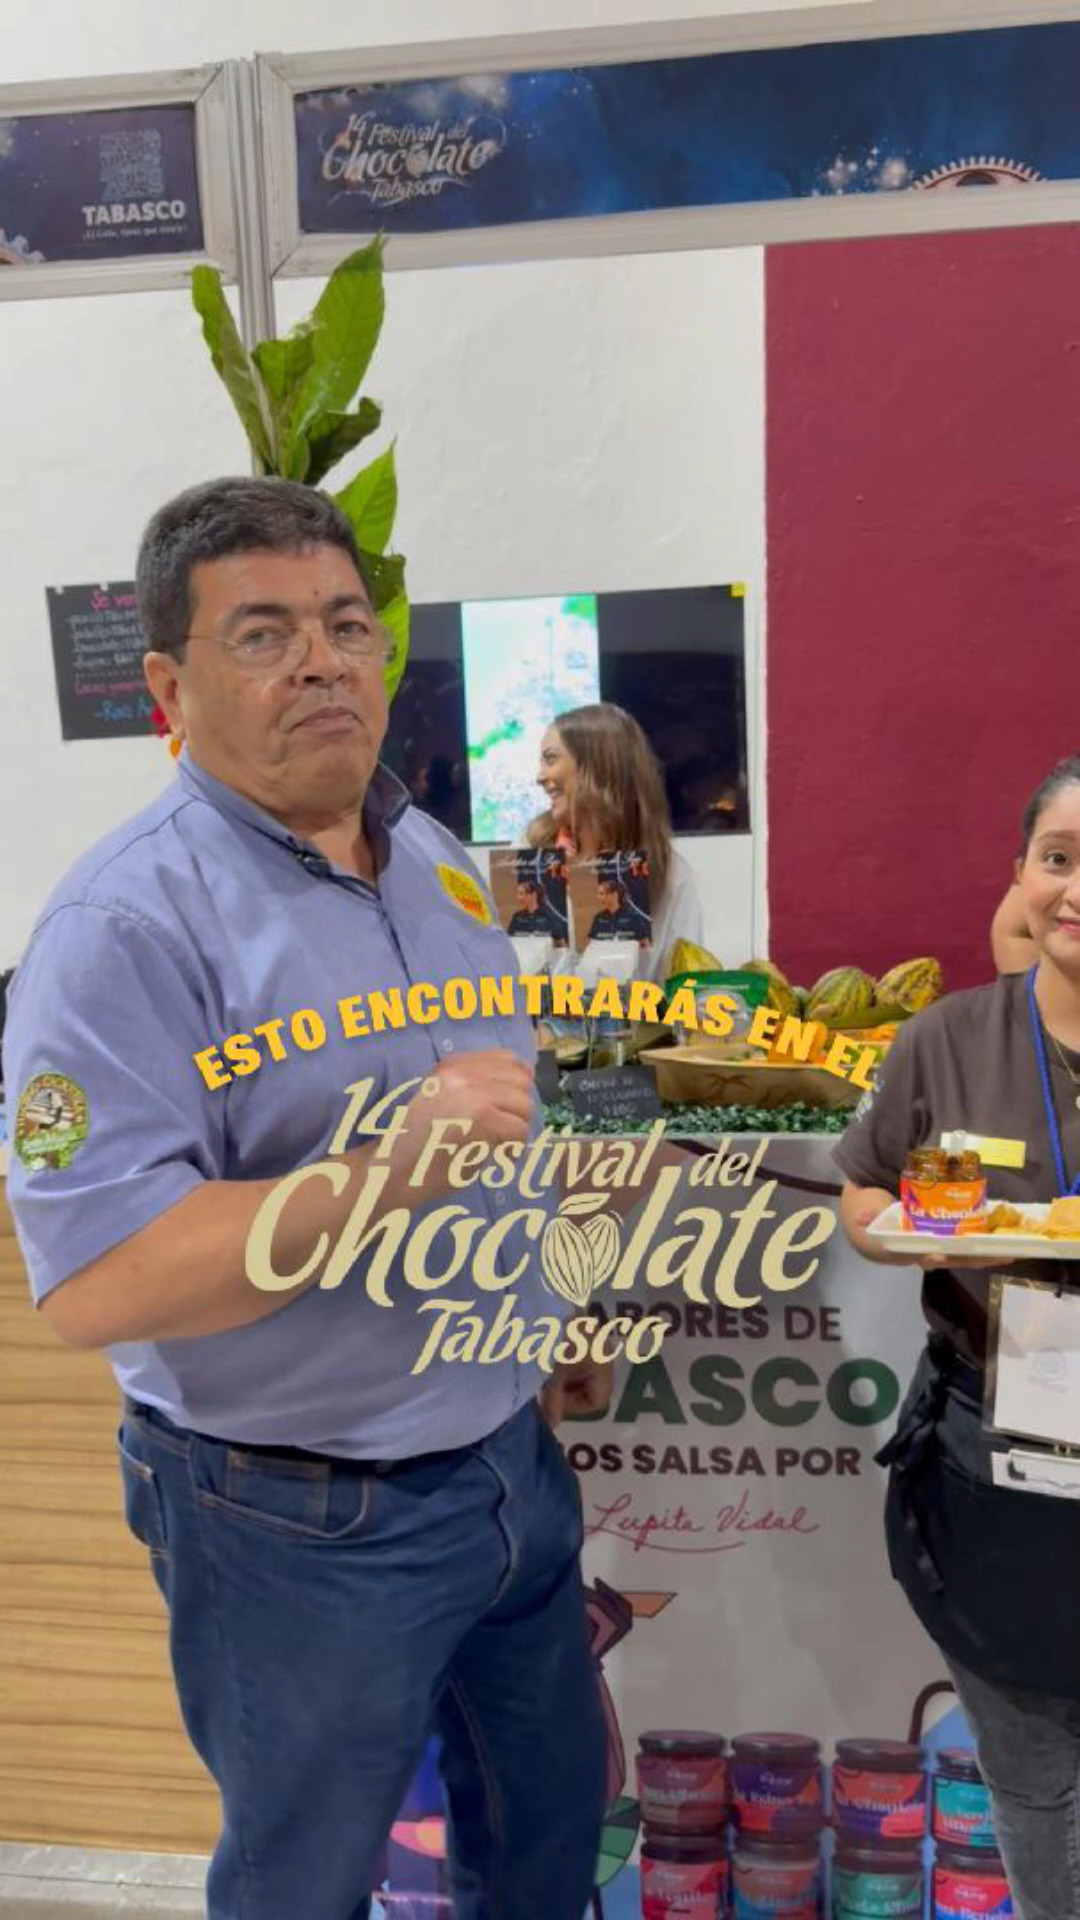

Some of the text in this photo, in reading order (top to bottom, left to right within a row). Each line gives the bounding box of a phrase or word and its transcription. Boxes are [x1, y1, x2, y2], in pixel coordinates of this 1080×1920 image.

[368, 119, 440, 145] Festival
[371, 177, 443, 203] Tabasco
[82, 199, 186, 226] TABASCO
[587, 1301, 843, 1341] ABORES DE
[562, 1354, 901, 1428] ASCO
[559, 1442, 862, 1478] OS SALSA POR
[585, 1488, 822, 1552] Lupita Vidal
